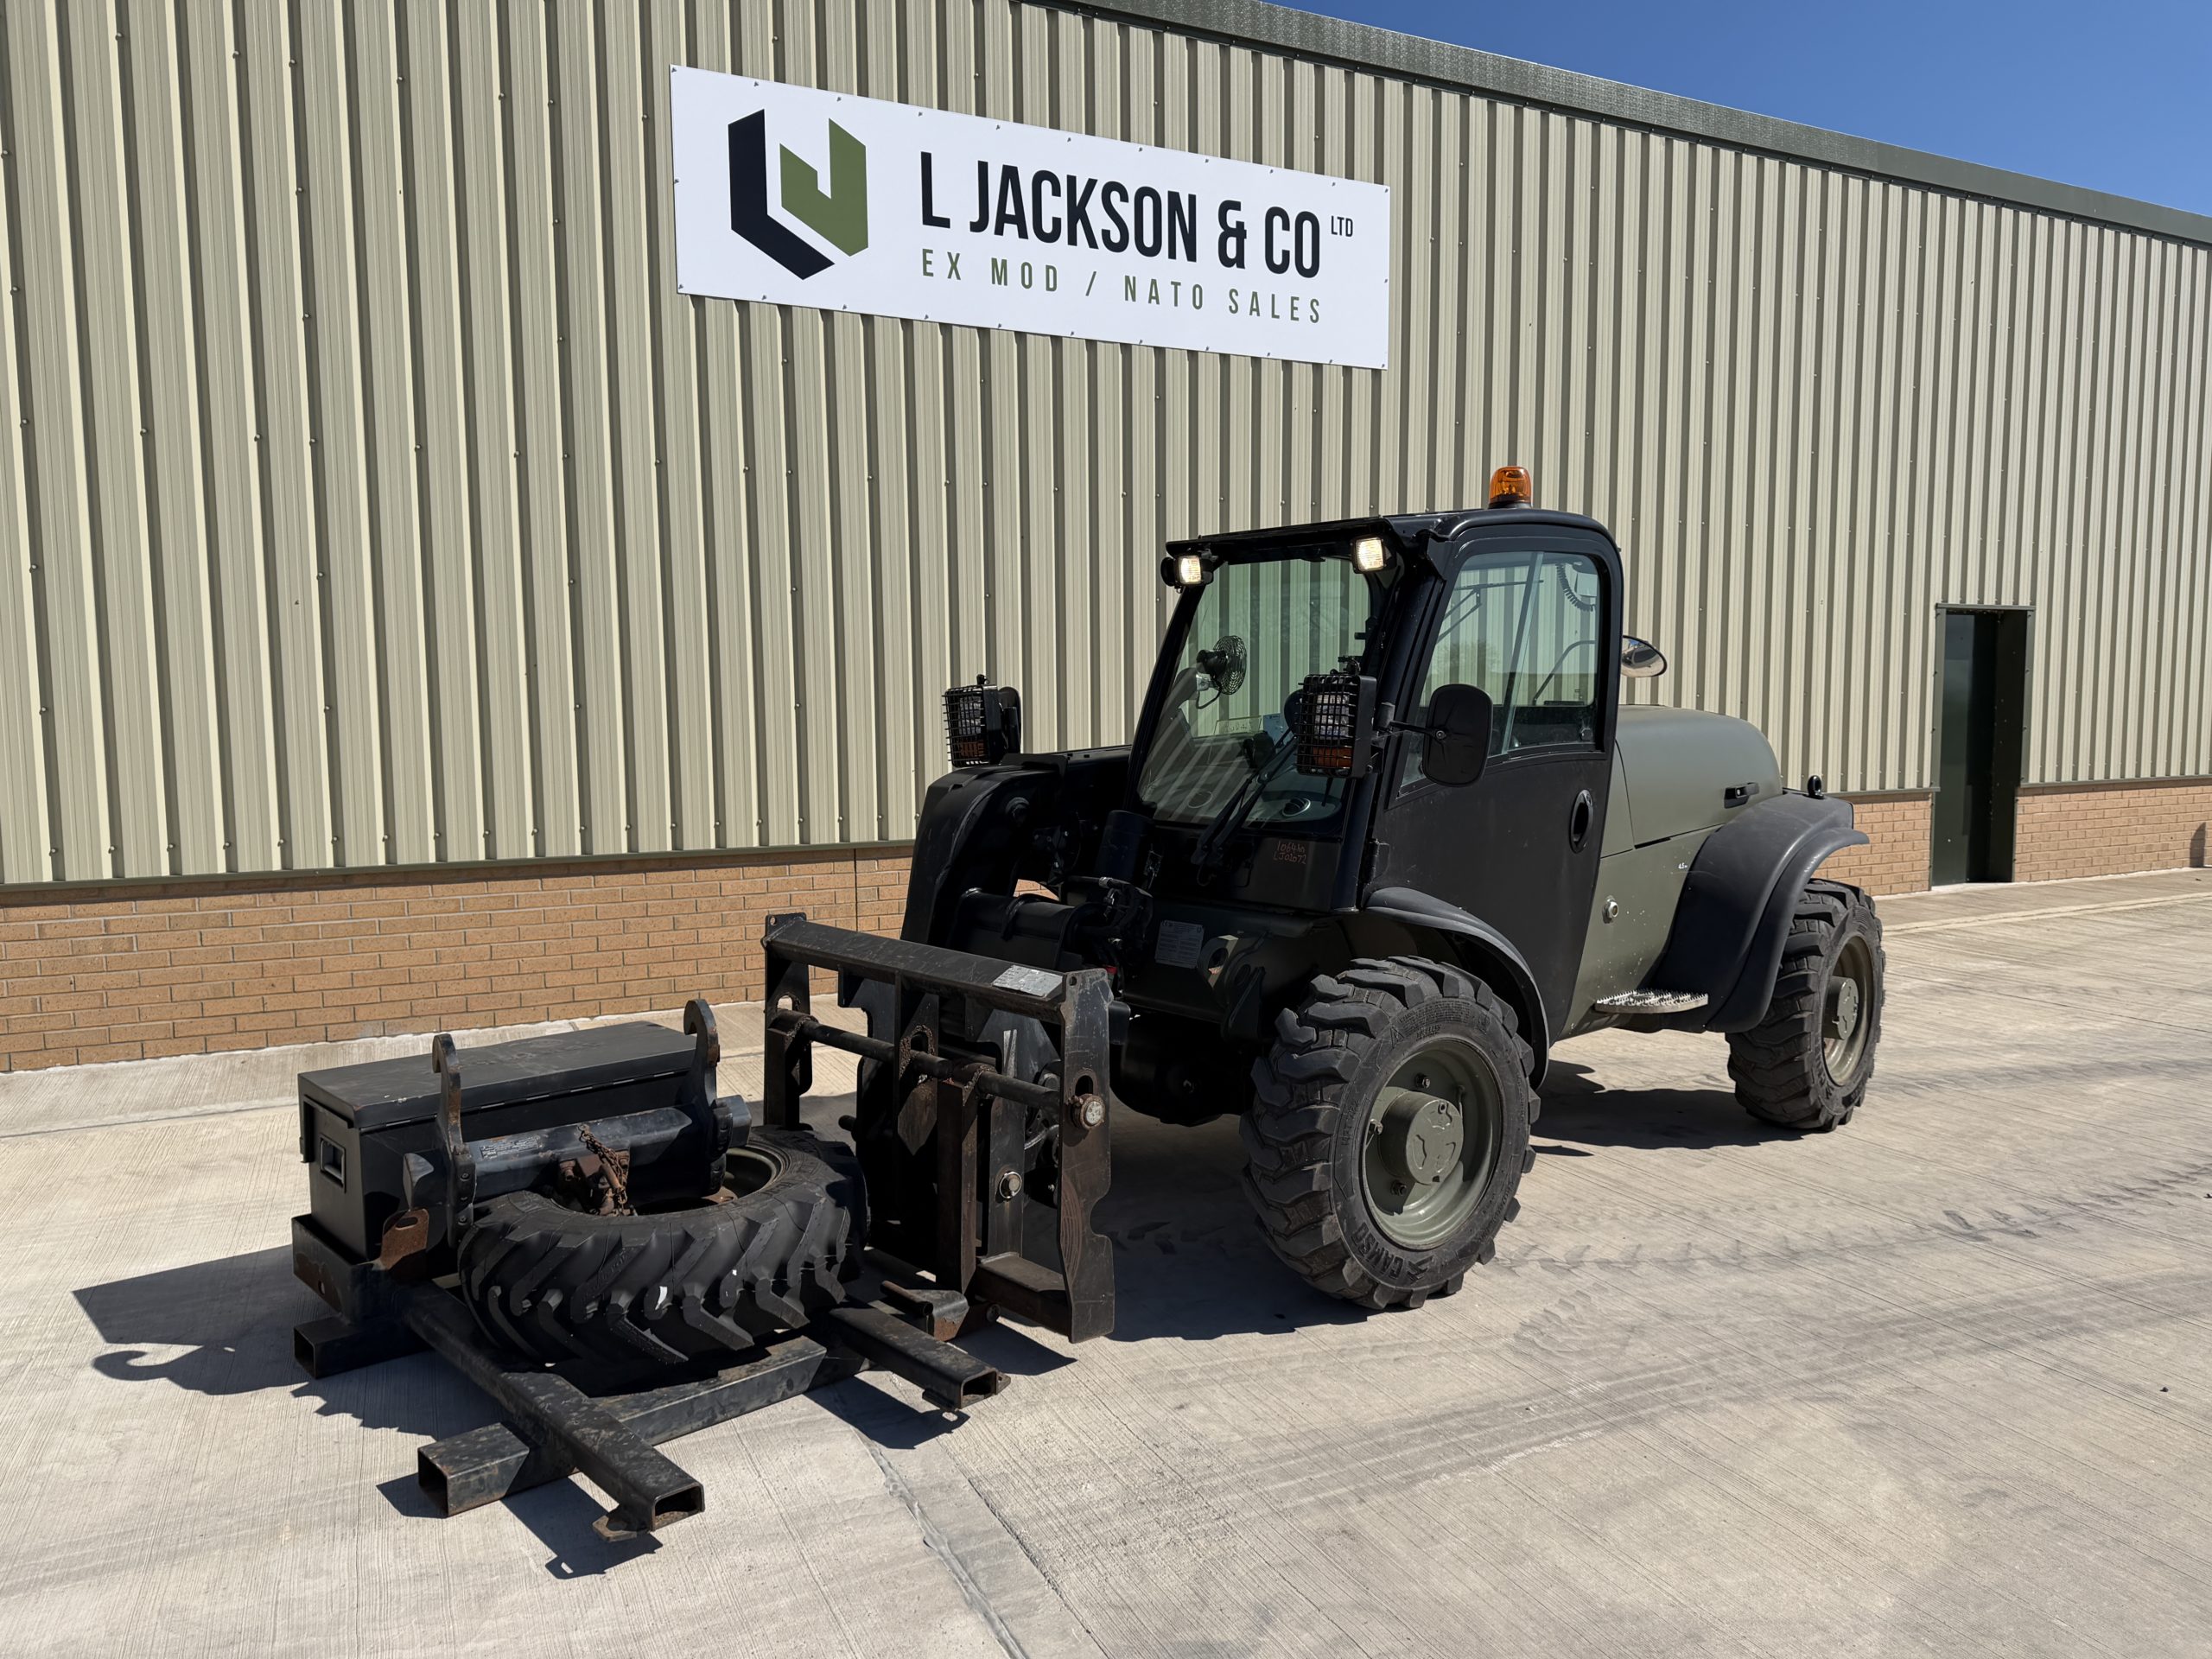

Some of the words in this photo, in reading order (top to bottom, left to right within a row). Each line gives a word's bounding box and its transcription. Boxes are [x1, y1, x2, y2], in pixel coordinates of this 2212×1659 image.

[920, 150, 951, 229] L
[969, 160, 1198, 264] JACKSON
[1217, 200, 1248, 270] &
[1264, 206, 1320, 279] CO
[1330, 214, 1354, 238] LTD
[921, 248, 962, 281] EX
[991, 257, 1058, 293] MOD
[1085, 270, 1097, 297] /
[1124, 275, 1203, 310] NATO
[1228, 288, 1319, 324] SALES
[1351, 1221, 1404, 1280] CAMSO
